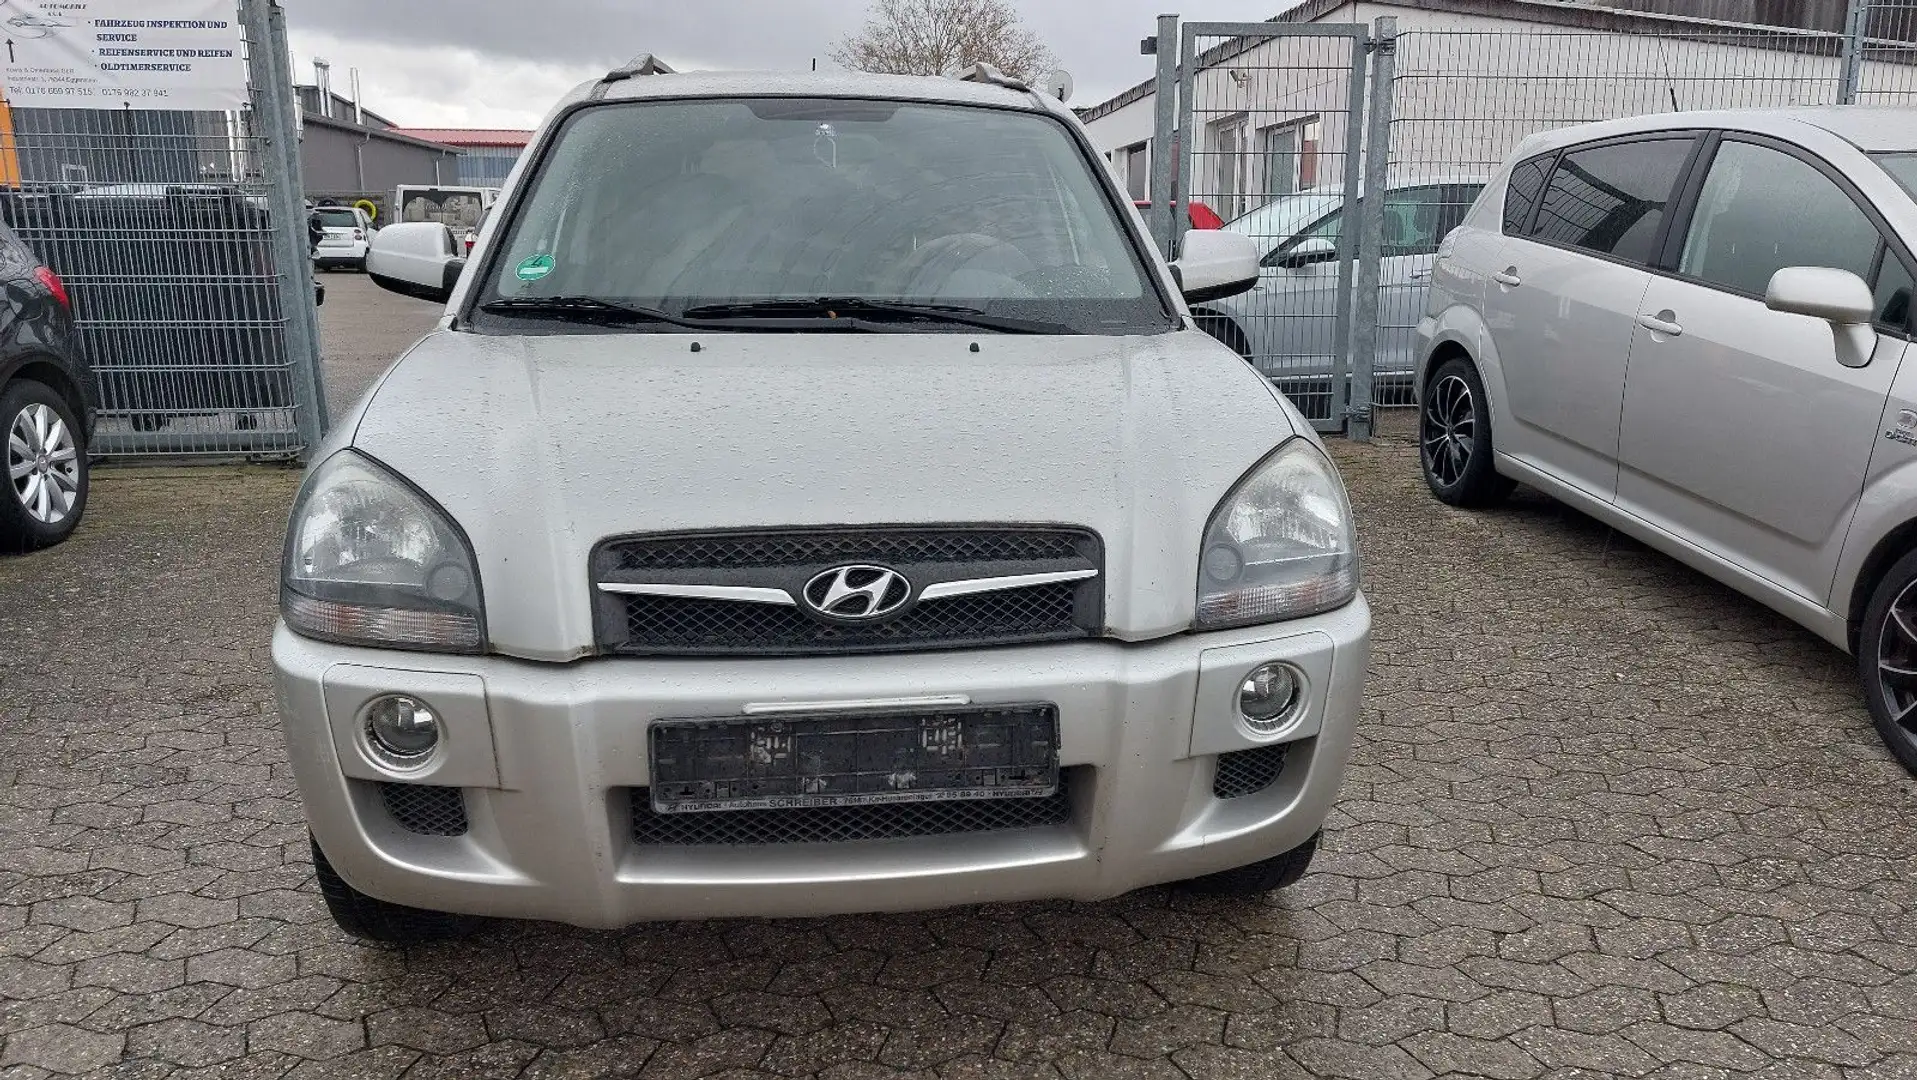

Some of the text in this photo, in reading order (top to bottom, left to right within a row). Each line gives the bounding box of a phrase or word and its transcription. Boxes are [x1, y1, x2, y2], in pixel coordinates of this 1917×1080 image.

[94, 19, 228, 29] FAHRZEUG INSPEKTION UND
[96, 33, 138, 42] SERVICE
[99, 48, 233, 58] REIFENSERVICE UND REIFEN
[100, 62, 192, 72] OLDTIMERSERVICE
[769, 797, 838, 808] SCHREIBER
